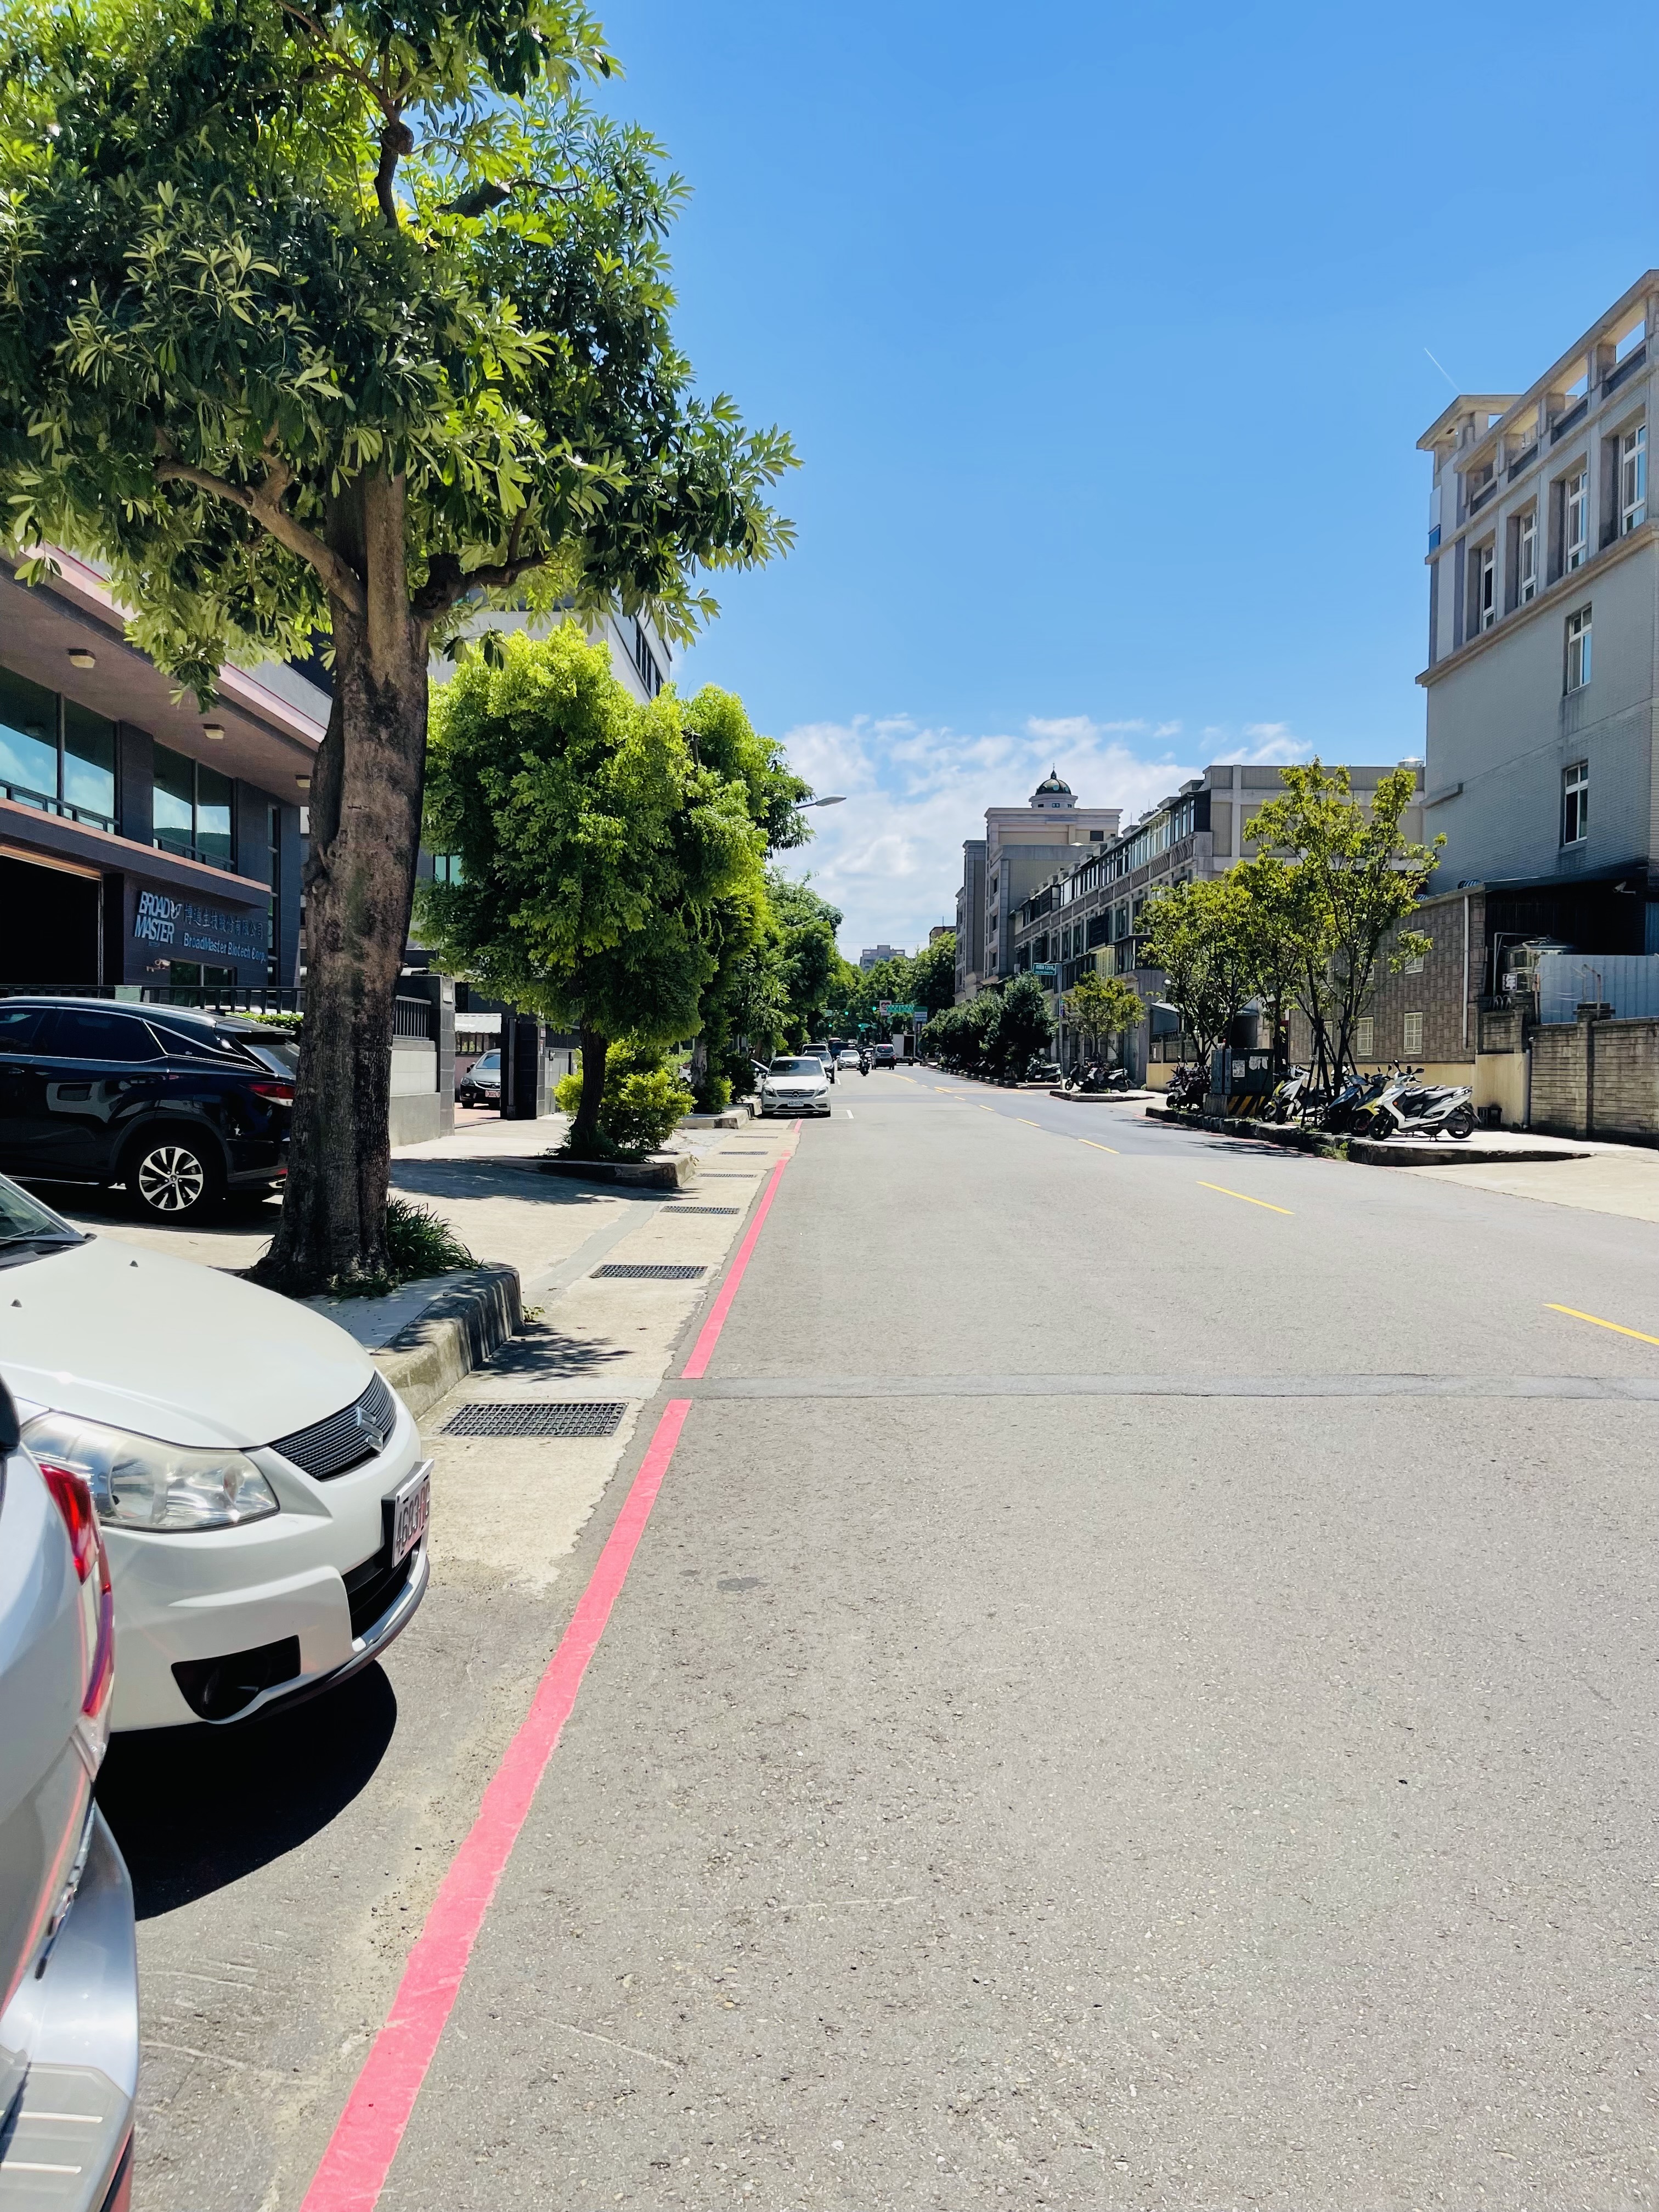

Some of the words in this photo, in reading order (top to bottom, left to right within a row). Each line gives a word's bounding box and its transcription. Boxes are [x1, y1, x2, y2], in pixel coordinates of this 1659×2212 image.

[139, 891, 170, 919] BROAD
[134, 915, 174, 944] MASTER
[184, 932, 227, 955] BroadMaster
[228, 942, 251, 959] Biotech
[251, 947, 266, 964] Corp.
